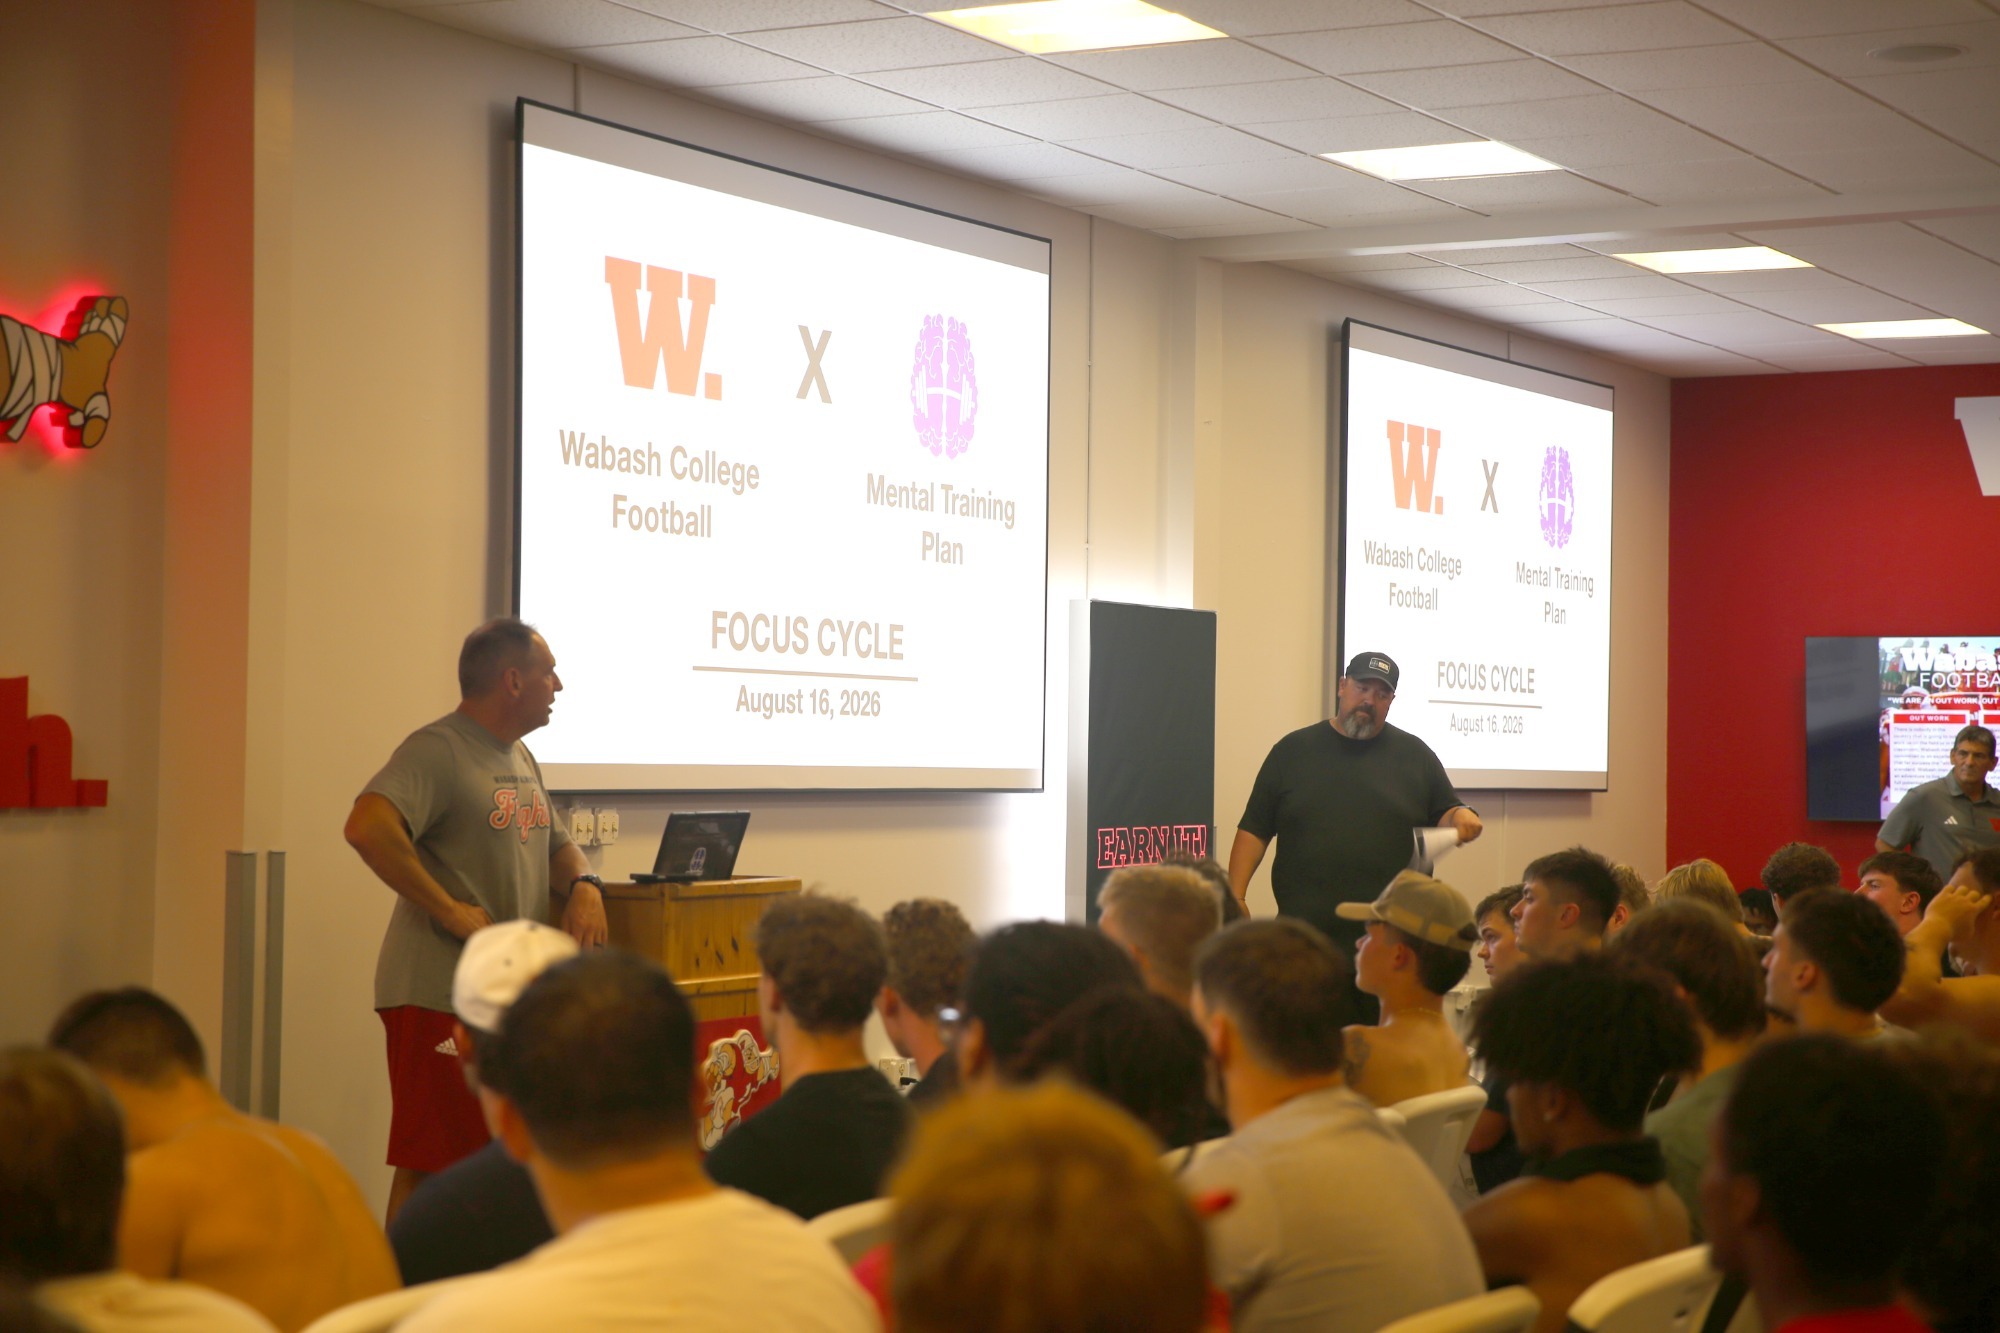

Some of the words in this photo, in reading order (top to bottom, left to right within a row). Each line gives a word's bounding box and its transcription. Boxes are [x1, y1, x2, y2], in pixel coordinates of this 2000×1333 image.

[796, 324, 833, 405] X
[559, 429, 662, 478] Wabash
[670, 445, 761, 497] College
[867, 473, 935, 513] Mental
[941, 484, 1016, 531] Training
[1480, 458, 1500, 514] X
[613, 494, 713, 539] Football
[922, 531, 965, 566] Plan
[1364, 540, 1415, 571] Wabash
[1417, 547, 1463, 581] College
[1389, 582, 1440, 612] Football
[1516, 562, 1552, 589] Mental
[1555, 567, 1595, 599] Training
[1544, 601, 1568, 626] Plan
[712, 610, 811, 656] FOCUS
[817, 618, 905, 662] CYCLE
[1437, 661, 1488, 693] FOCUS
[1491, 665, 1536, 696] CYCLE
[1900, 647, 2000, 671] Waba
[736, 685, 805, 722] August
[810, 689, 836, 722] 16,
[840, 689, 882, 718] 2026
[1450, 712, 1484, 737] August
[1486, 714, 1500, 736] 16,
[1502, 715, 1524, 735] 2026
[1097, 825, 1170, 869] EARN
